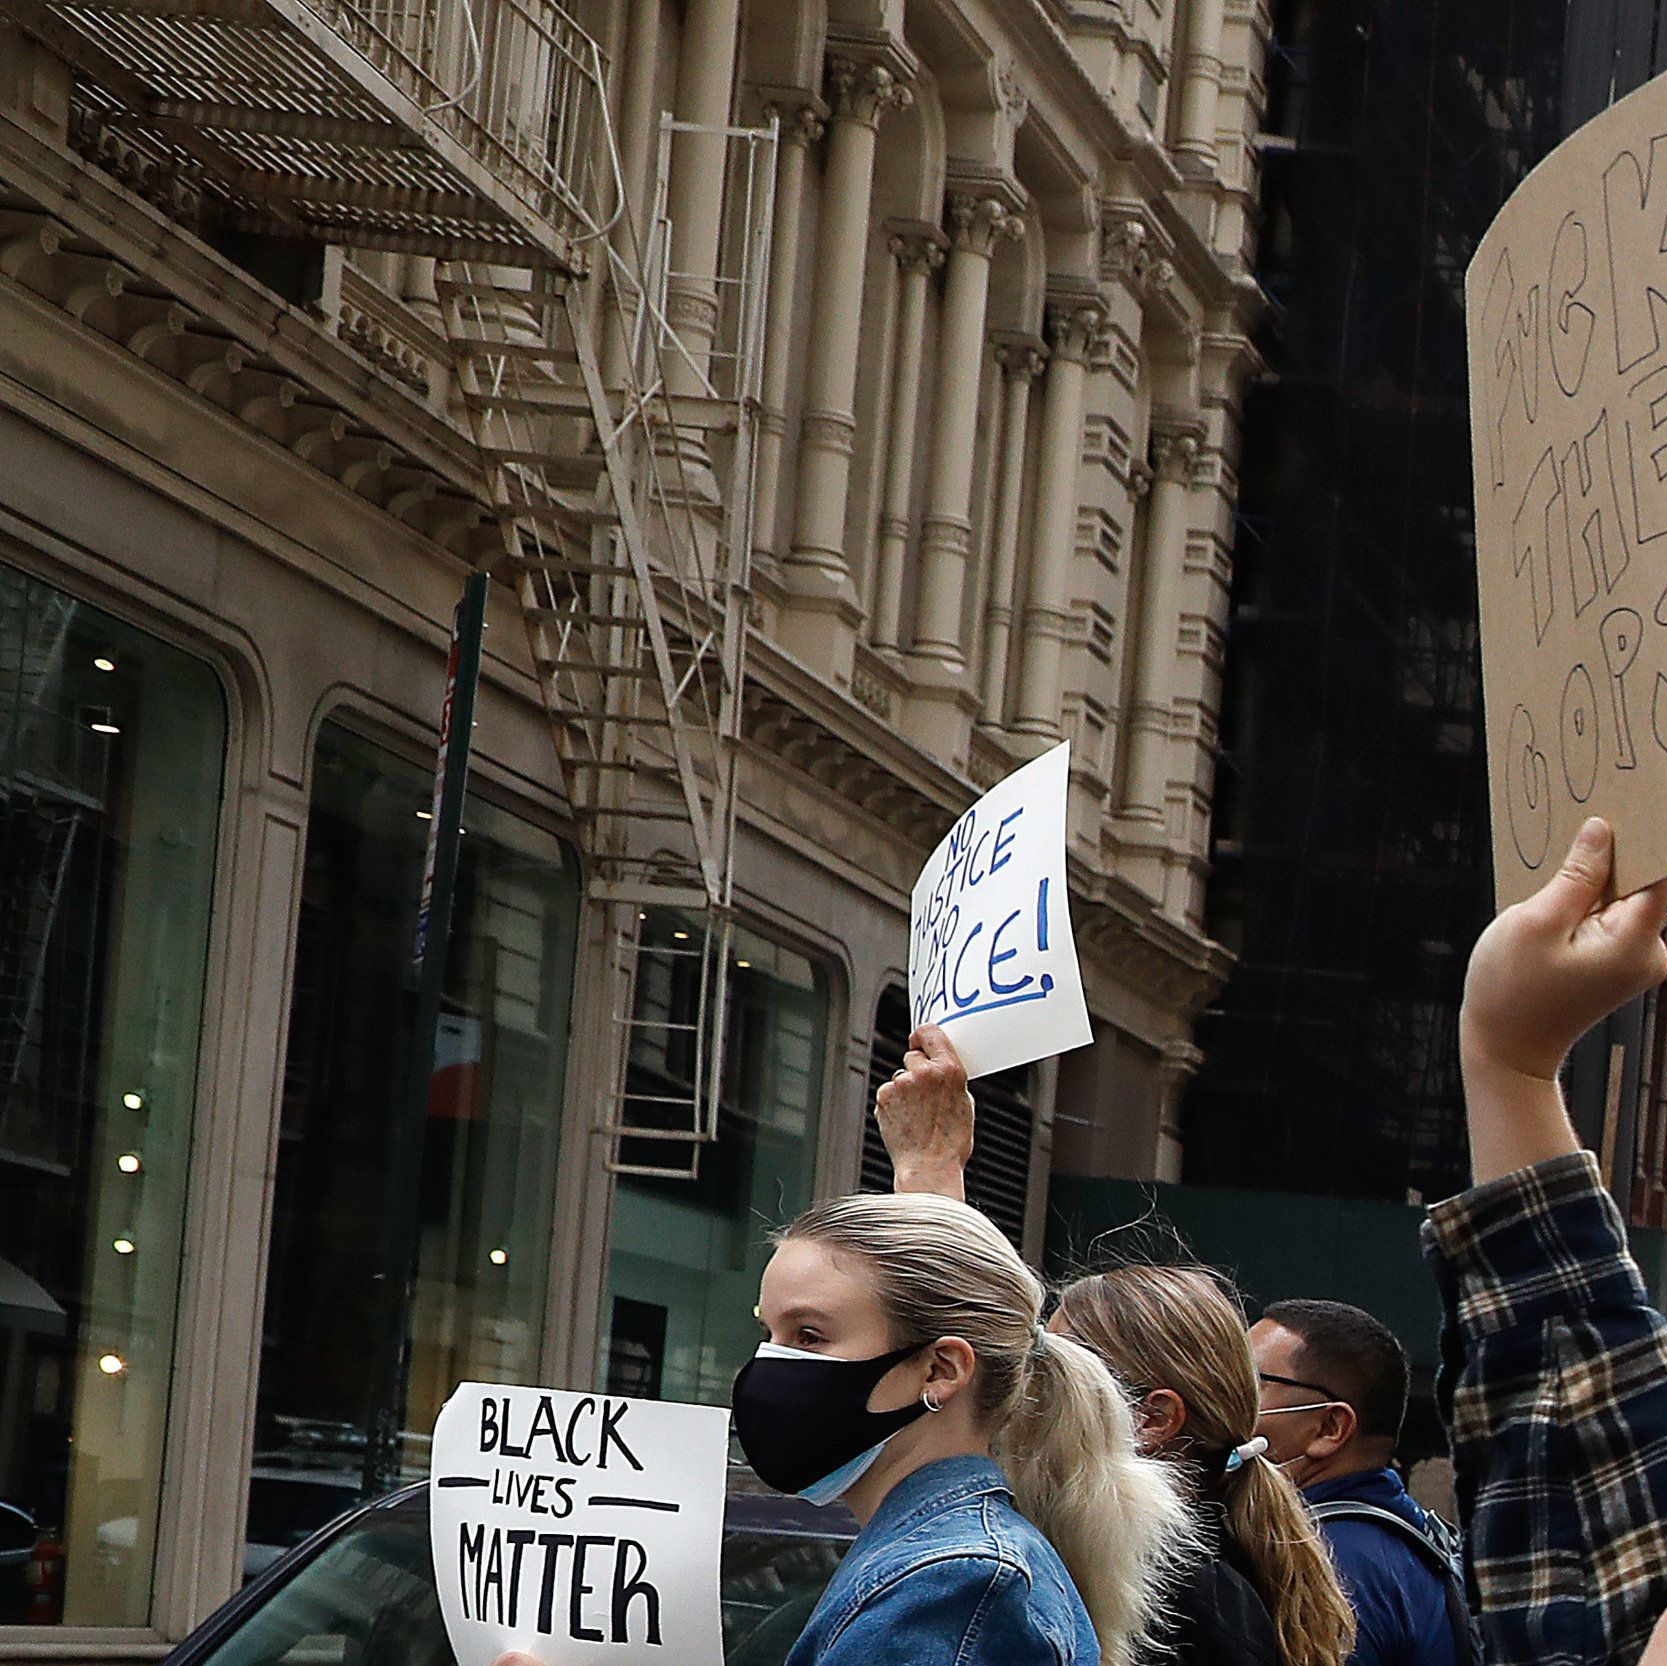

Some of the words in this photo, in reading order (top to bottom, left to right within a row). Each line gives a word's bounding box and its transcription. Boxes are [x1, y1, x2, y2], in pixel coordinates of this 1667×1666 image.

[945, 809, 976, 873] NO
[912, 806, 1025, 977] JUSTICE
[928, 904, 960, 970] NO
[479, 1395, 644, 1472] BLACK
[491, 1468, 577, 1518] LIVES
[459, 1522, 663, 1646] MATTER
